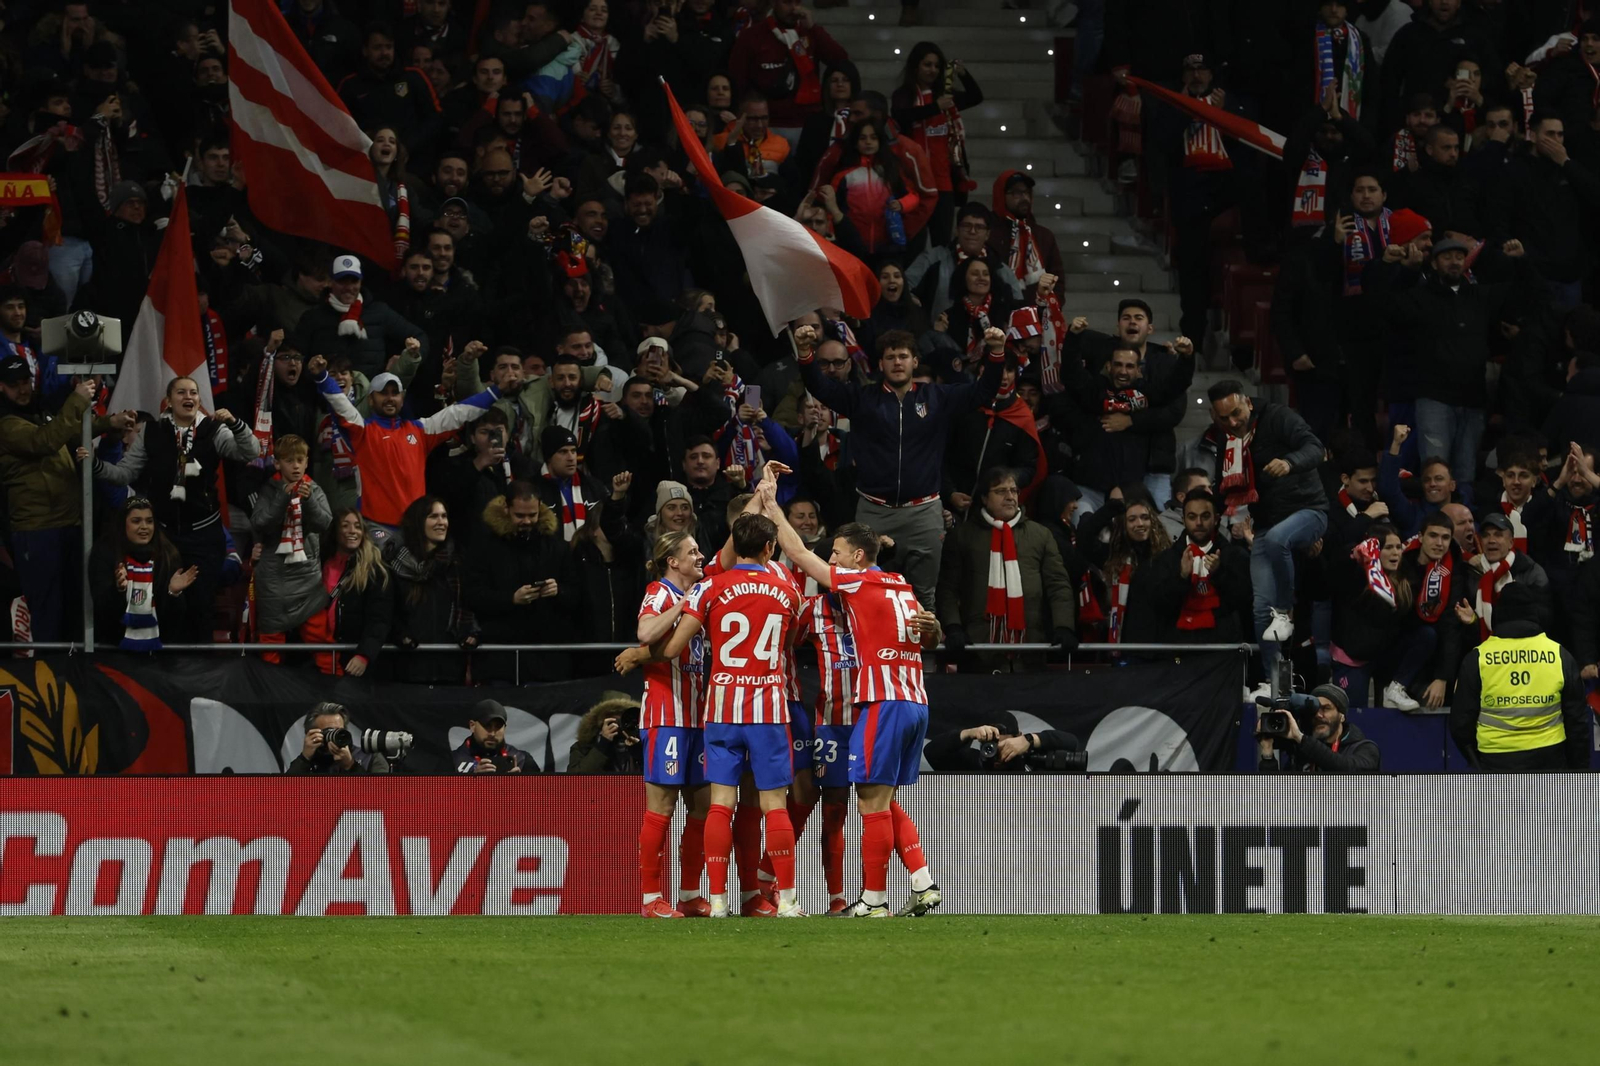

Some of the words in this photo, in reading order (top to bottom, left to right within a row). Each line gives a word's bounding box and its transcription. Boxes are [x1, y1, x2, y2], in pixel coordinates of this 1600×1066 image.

[719, 588, 735, 605] LE
[733, 583, 791, 609] NORMAND
[886, 588, 921, 643] 15
[719, 611, 783, 670] 24
[1485, 649, 1556, 665] SEGURIDAD
[1510, 671, 1531, 686] 80
[1497, 695, 1554, 705] PROSEGUR
[664, 736, 678, 759] 4
[812, 738, 838, 763] 23
[0, 810, 570, 915] ComAve
[1098, 799, 1367, 913] ÚNETE
